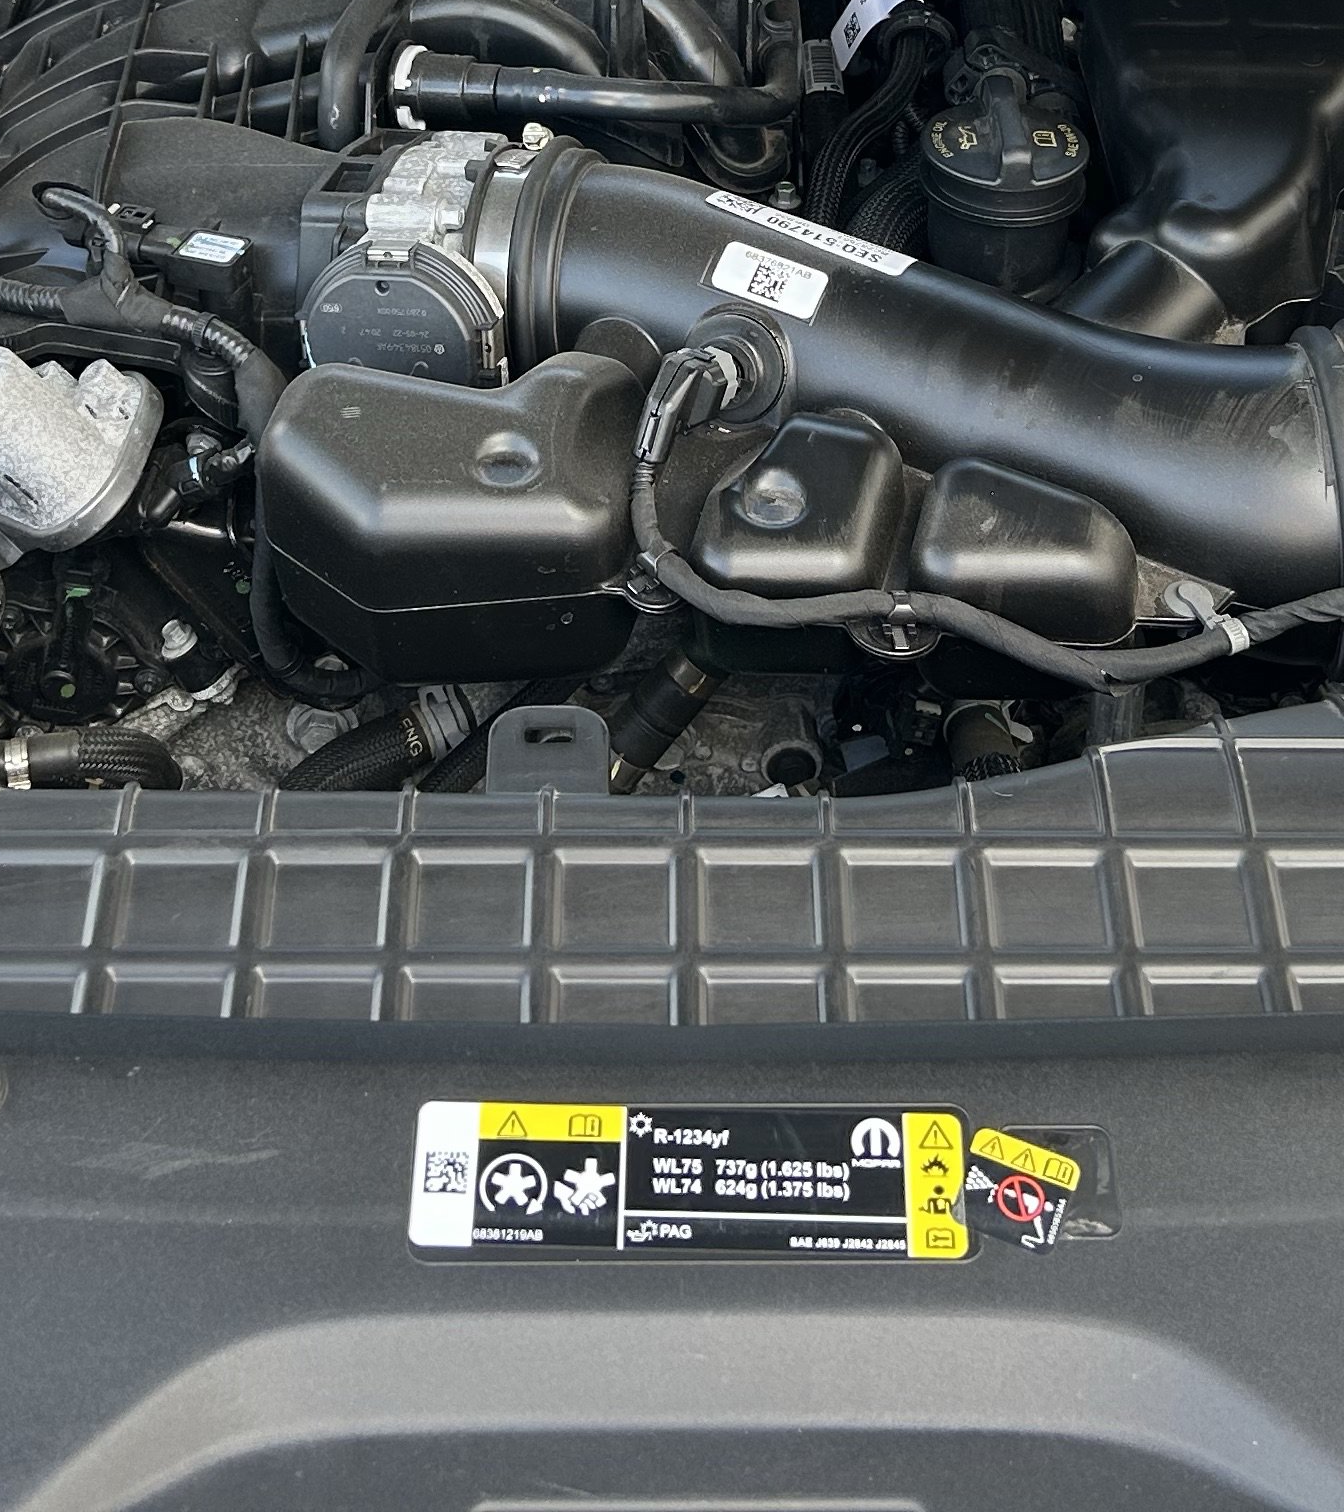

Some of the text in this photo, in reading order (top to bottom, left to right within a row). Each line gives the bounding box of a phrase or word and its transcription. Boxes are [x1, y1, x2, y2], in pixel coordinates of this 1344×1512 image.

[930, 131, 955, 159] ENGINE
[652, 1128, 730, 1149] R-1234yf
[652, 1158, 850, 1180] WL75 737g (1.625 lbs)
[851, 1157, 901, 1168] MOPAR
[652, 1177, 850, 1201] WL74 624g (1.375 lbs)
[659, 1224, 692, 1240] PAG
